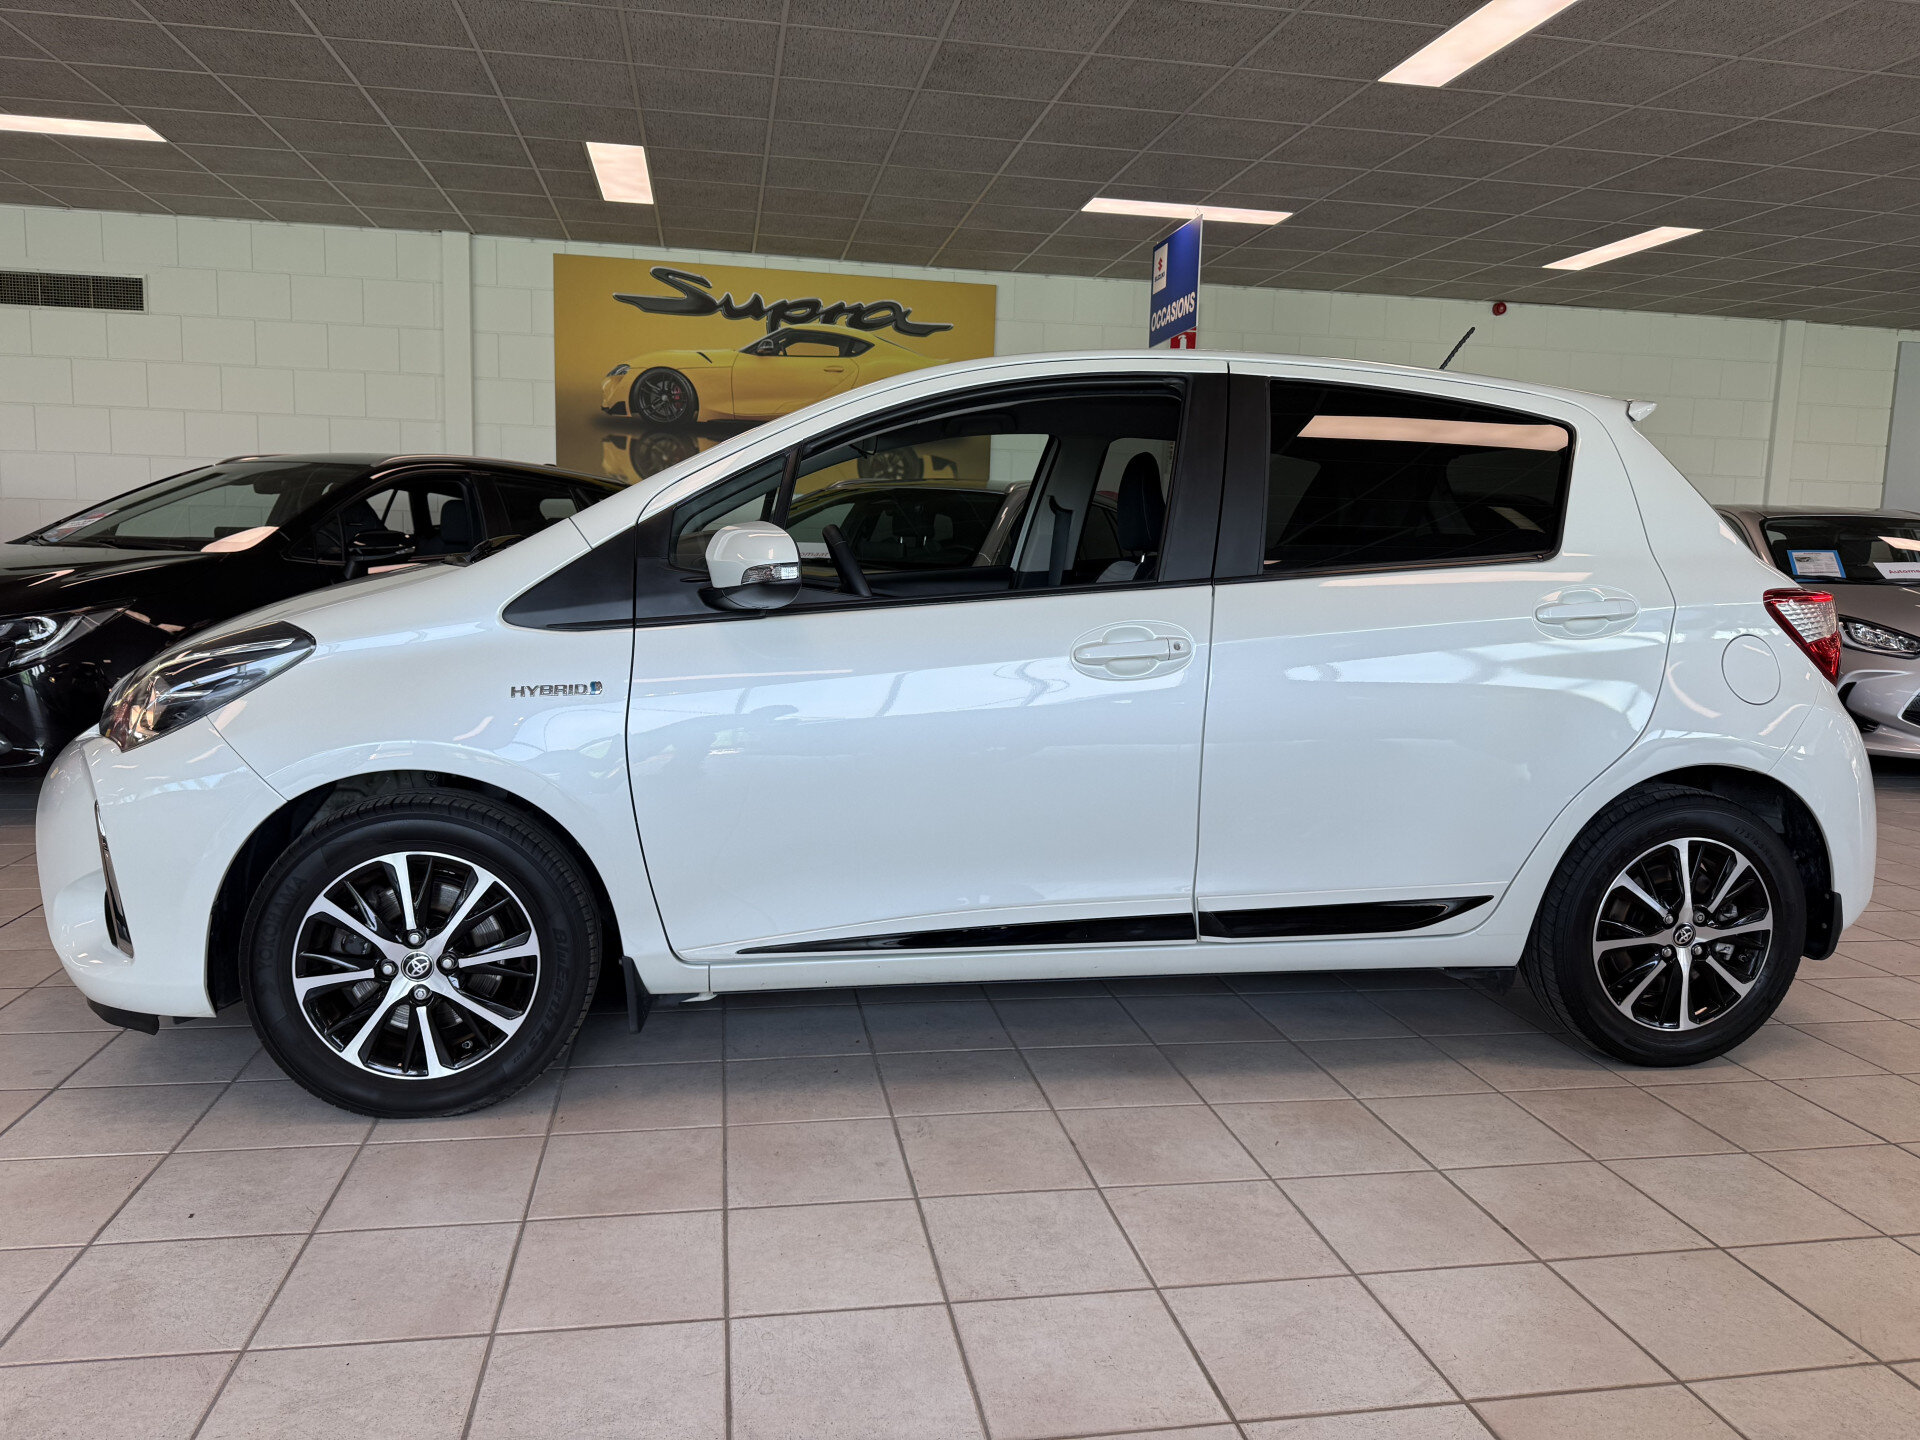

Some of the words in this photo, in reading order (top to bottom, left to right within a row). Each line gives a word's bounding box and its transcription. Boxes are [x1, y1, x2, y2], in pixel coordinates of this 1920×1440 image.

[1154, 271, 1165, 282] SUZUKI
[612, 266, 954, 337] Supra
[1151, 291, 1196, 332] OCCASIONS
[510, 683, 588, 699] HYBRID
[255, 876, 308, 971] YOKOHAMA
